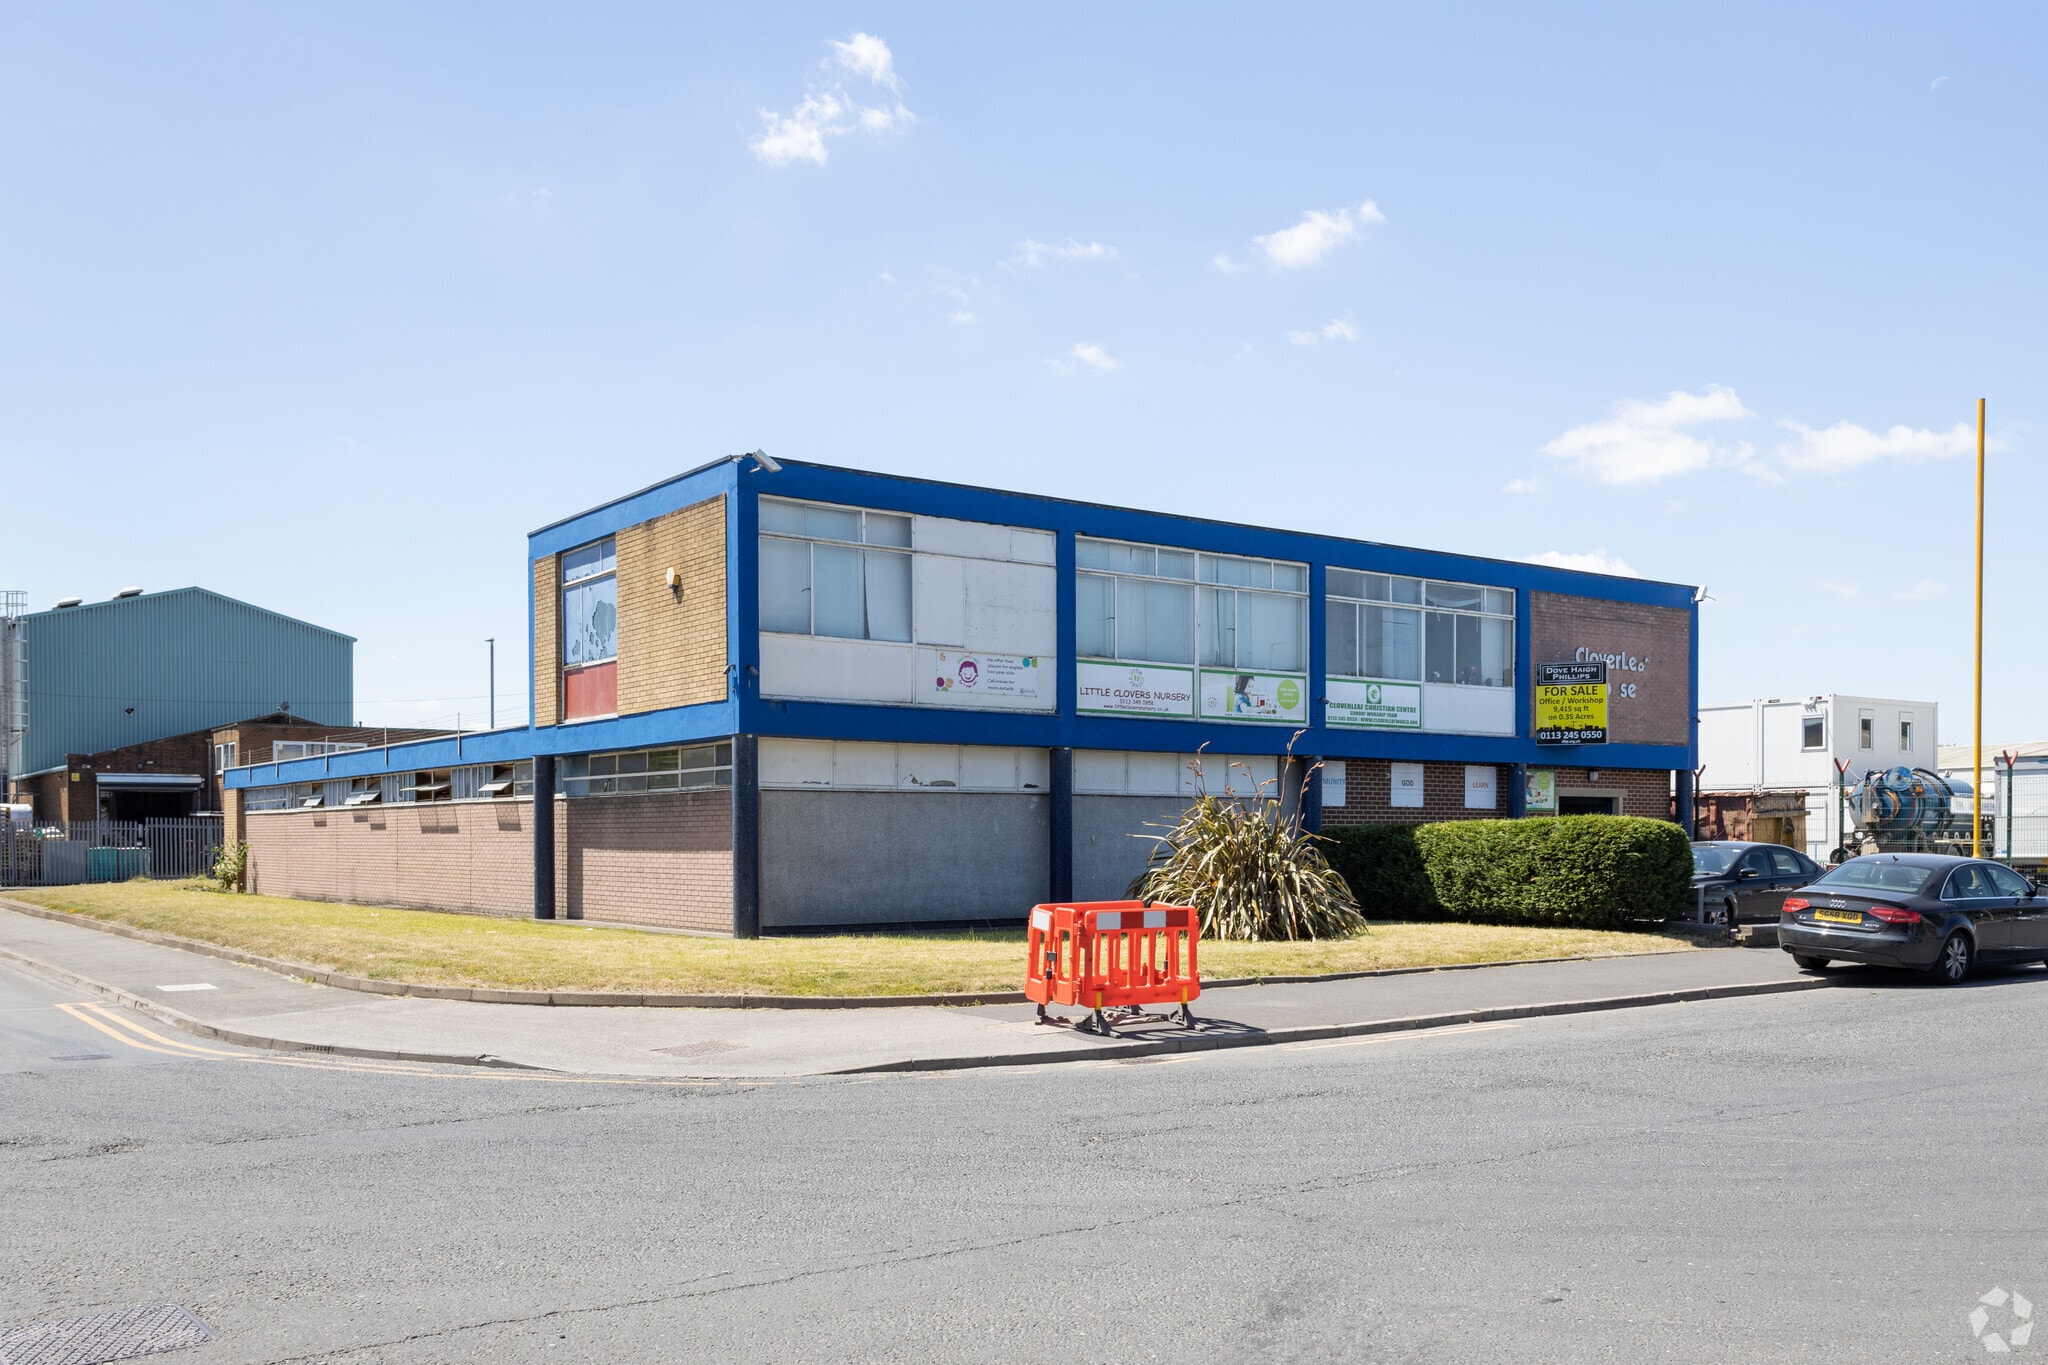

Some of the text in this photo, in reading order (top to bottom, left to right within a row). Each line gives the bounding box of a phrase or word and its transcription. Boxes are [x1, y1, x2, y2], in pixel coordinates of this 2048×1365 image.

[1575, 646, 1649, 672] CloverLea
[1546, 666, 1568, 674] DOVE
[1079, 687, 1191, 702] LITTLE CLOVERS NURSERY
[1544, 685, 1598, 697] FOR SALE
[1539, 697, 1560, 705] Office
[1567, 696, 1604, 705] Workshop
[1329, 702, 1364, 710] CLOVERLEAF
[1364, 704, 1396, 712] CHRISTIAN
[1553, 705, 1572, 713] 9,415
[1540, 730, 1602, 740] 0113 245 0550
[1401, 779, 1414, 787] GOD
[1472, 781, 1489, 789] LEARN
